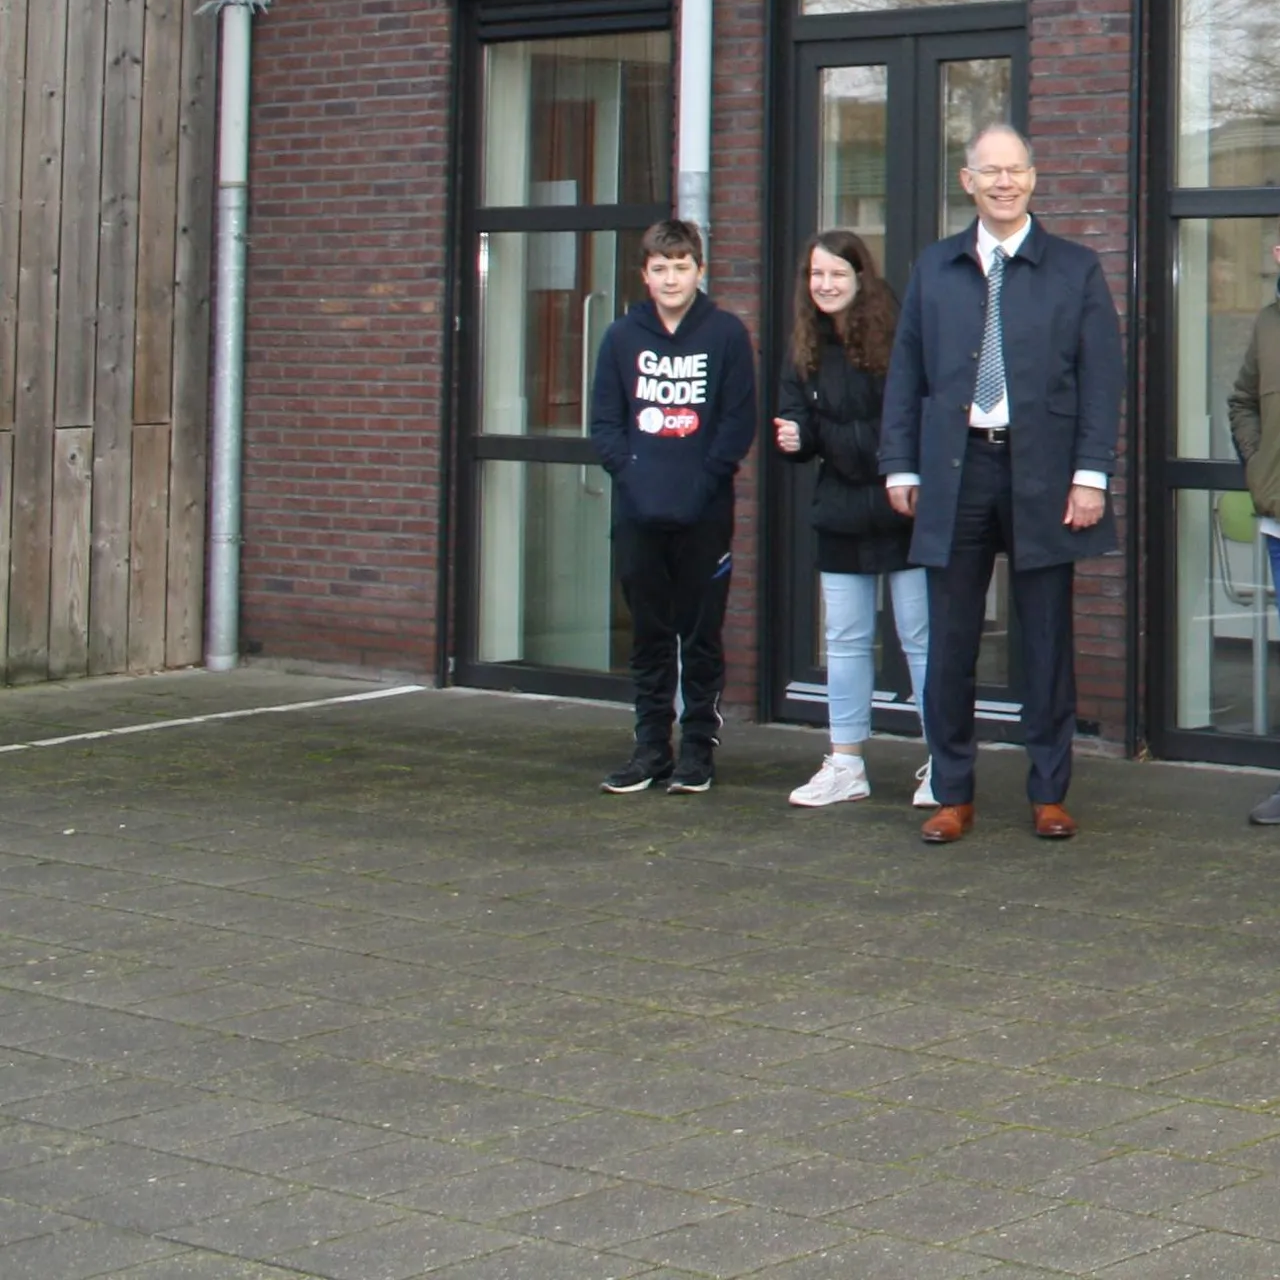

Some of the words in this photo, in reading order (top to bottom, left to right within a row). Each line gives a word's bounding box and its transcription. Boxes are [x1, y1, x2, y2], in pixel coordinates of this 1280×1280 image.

[637, 349, 709, 379] GAME
[635, 376, 708, 405] MODE
[664, 415, 695, 429] OFF
